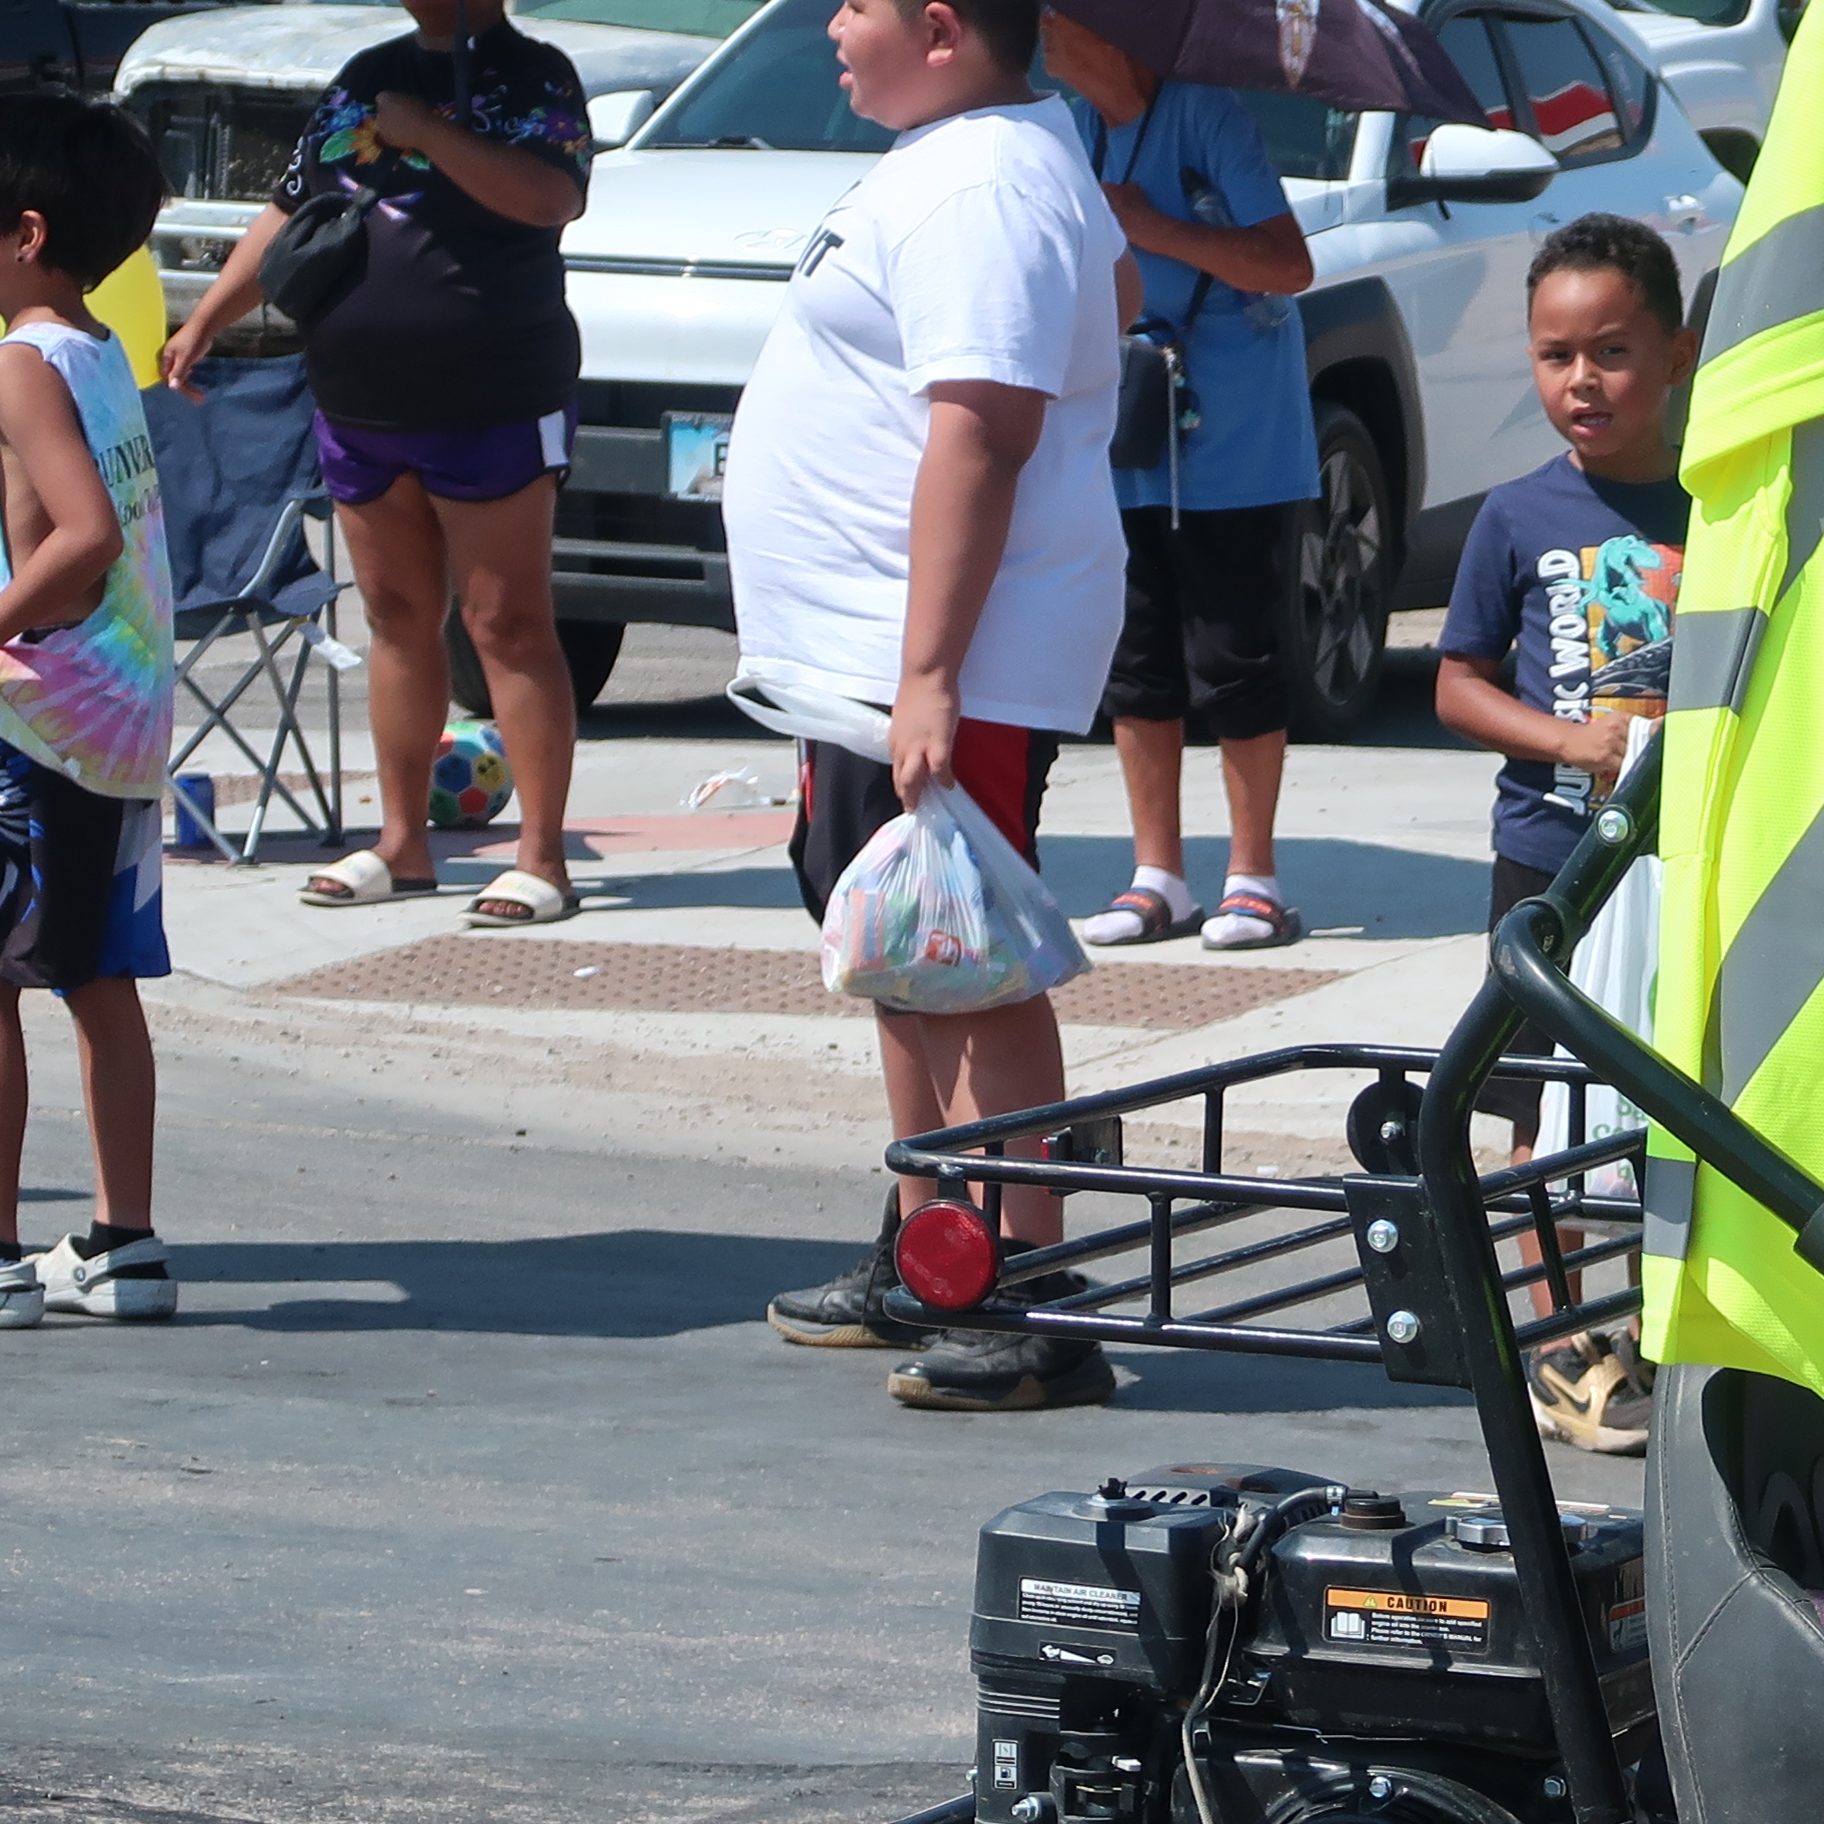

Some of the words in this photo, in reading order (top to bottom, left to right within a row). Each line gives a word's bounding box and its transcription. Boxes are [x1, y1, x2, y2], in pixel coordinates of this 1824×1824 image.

[1537, 549, 1590, 678] WORLD
[1550, 681, 1592, 816] JURSIC
[1033, 1583, 1072, 1595] MAINTAIN
[1073, 1587, 1087, 1597] AIR
[1088, 1589, 1128, 1601] CLEANER
[1387, 1596, 1448, 1612] CAUTION
